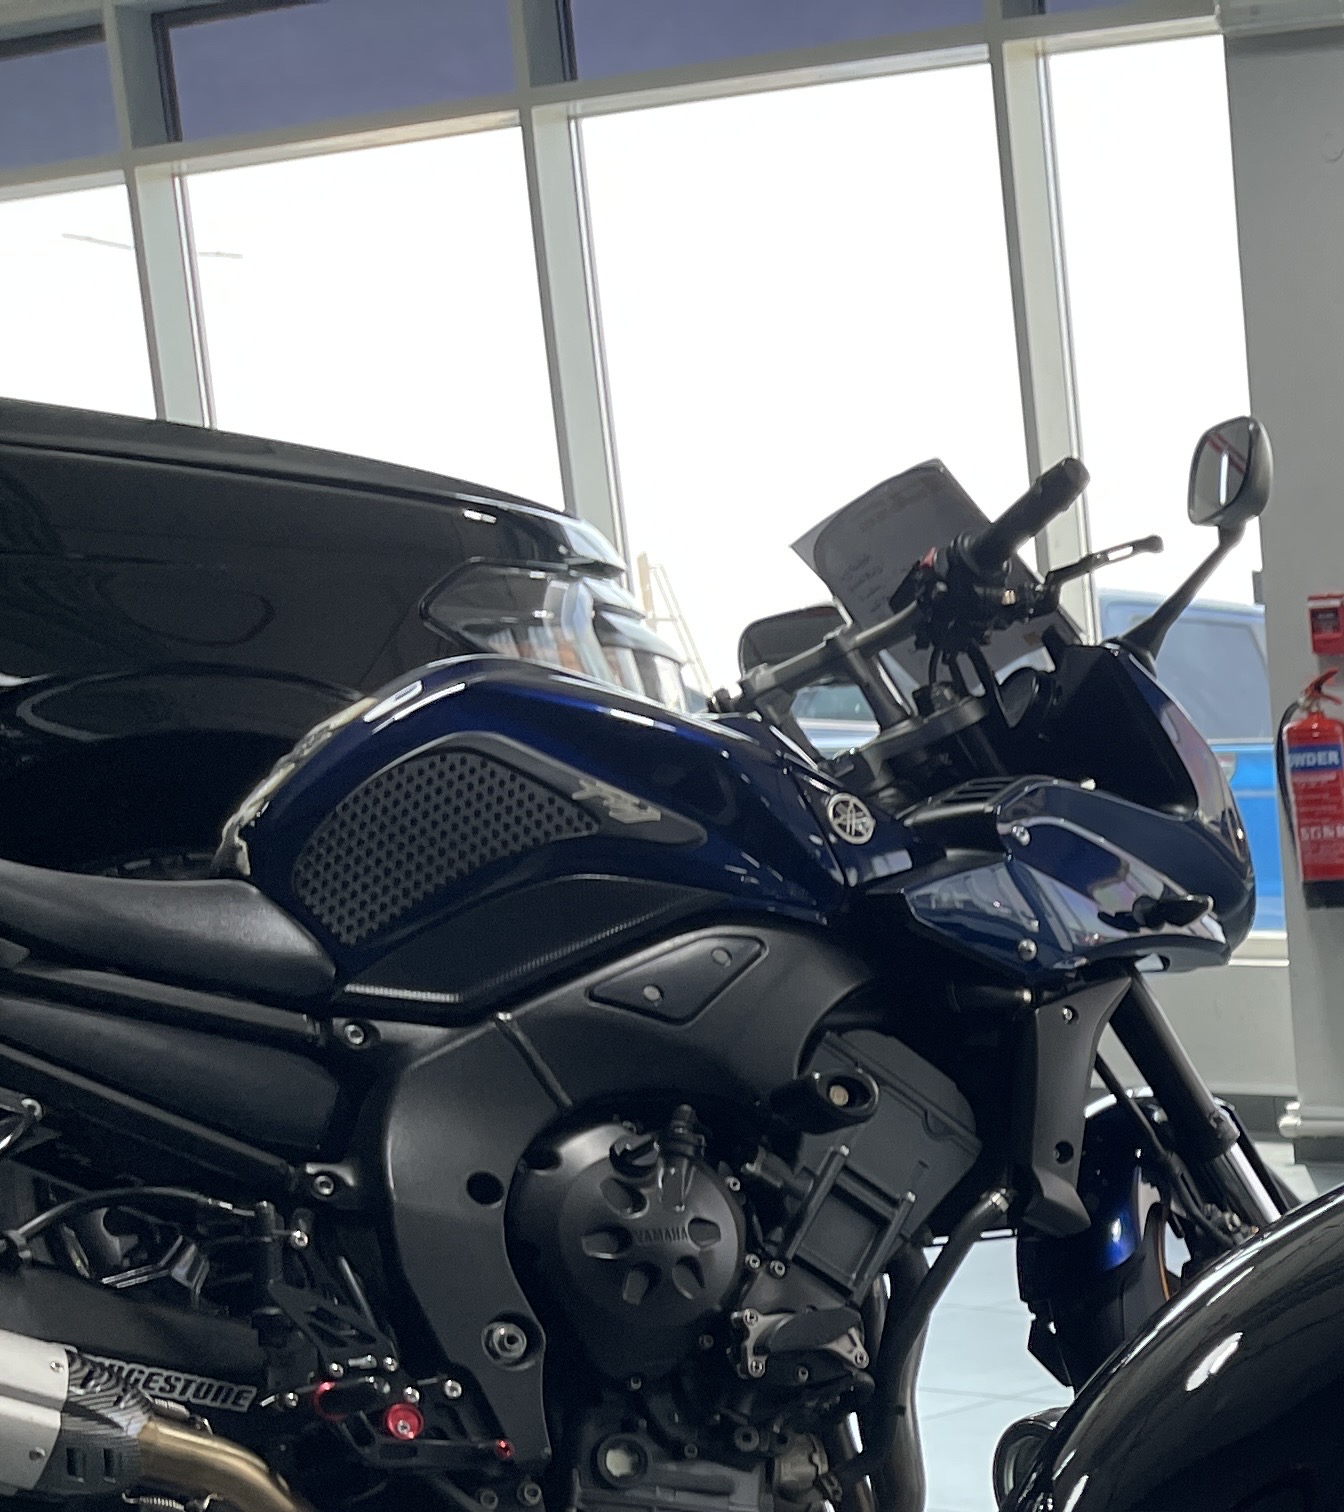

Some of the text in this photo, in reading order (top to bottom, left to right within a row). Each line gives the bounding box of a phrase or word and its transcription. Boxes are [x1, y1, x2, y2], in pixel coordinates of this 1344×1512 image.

[1288, 751, 1340, 767] WDER
[634, 1226, 689, 1243] YAMAHA
[103, 1360, 256, 1411] GESTONE
